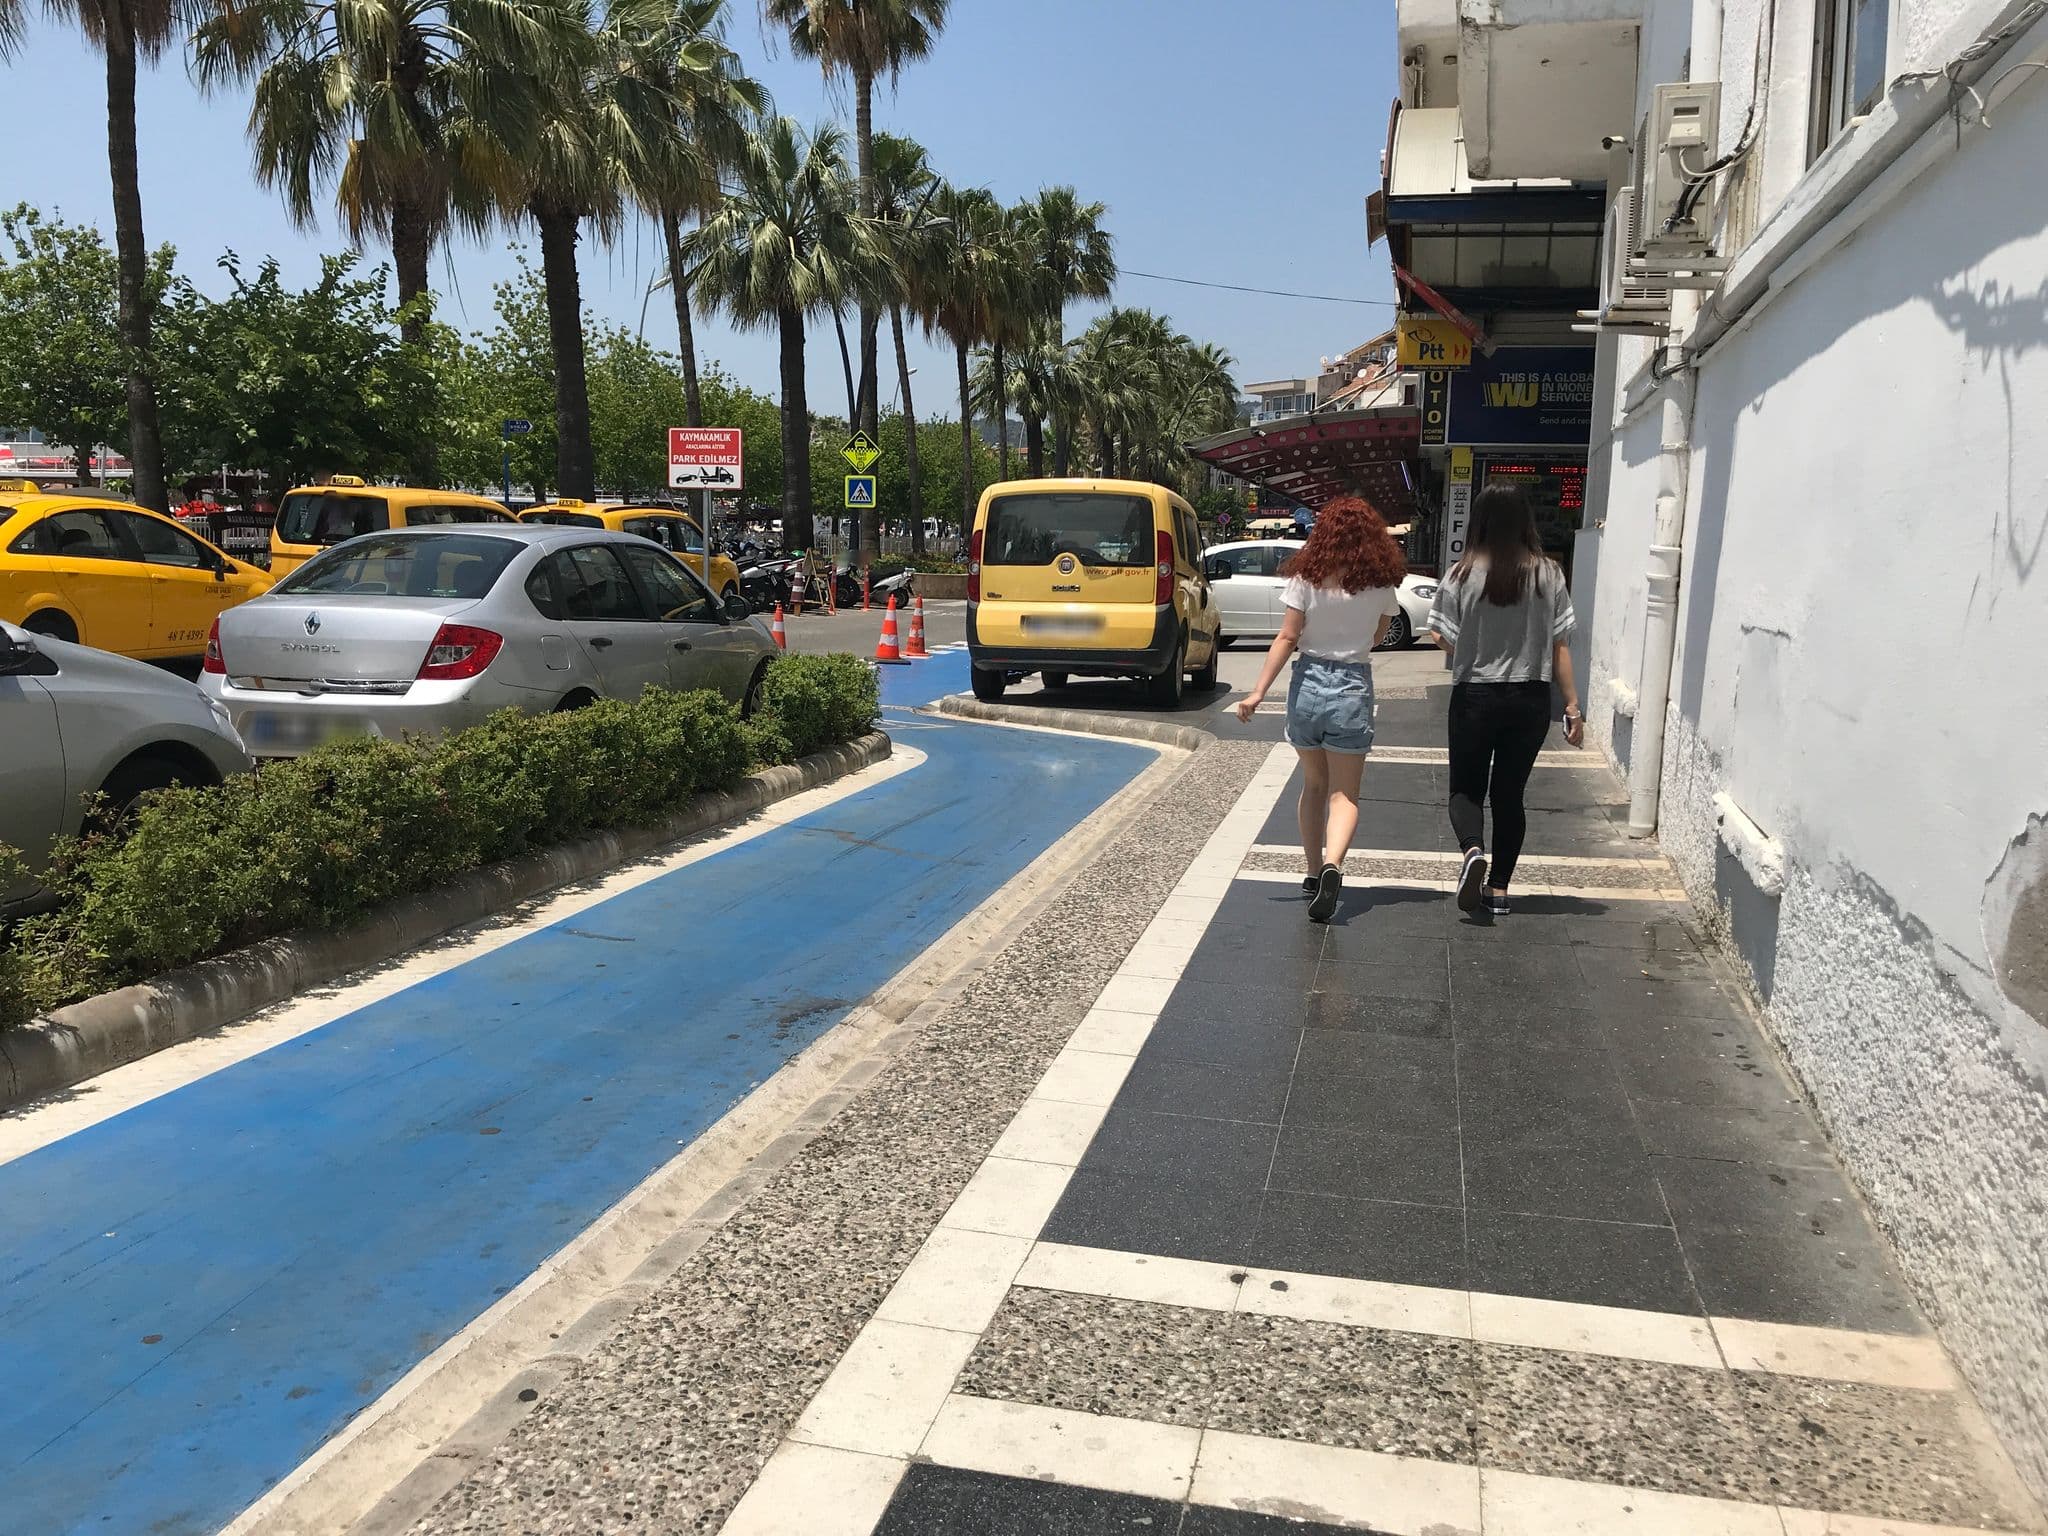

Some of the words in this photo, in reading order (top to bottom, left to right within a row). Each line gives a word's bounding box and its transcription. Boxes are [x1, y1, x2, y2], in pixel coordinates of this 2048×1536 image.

[1419, 343, 1445, 360] Ptt
[1500, 372, 1525, 382] THIS
[1528, 372, 1540, 382] IS
[1542, 372, 1552, 382] A
[1541, 382, 1555, 392] IN
[1482, 382, 1539, 407] WU
[1541, 392, 1593, 402] SERVICE
[679, 432, 732, 442] KAYMAKAMLIK
[673, 454, 697, 463] PARK
[698, 453, 738, 464] EDİLMEZ
[280, 640, 342, 654] SYMBOL
